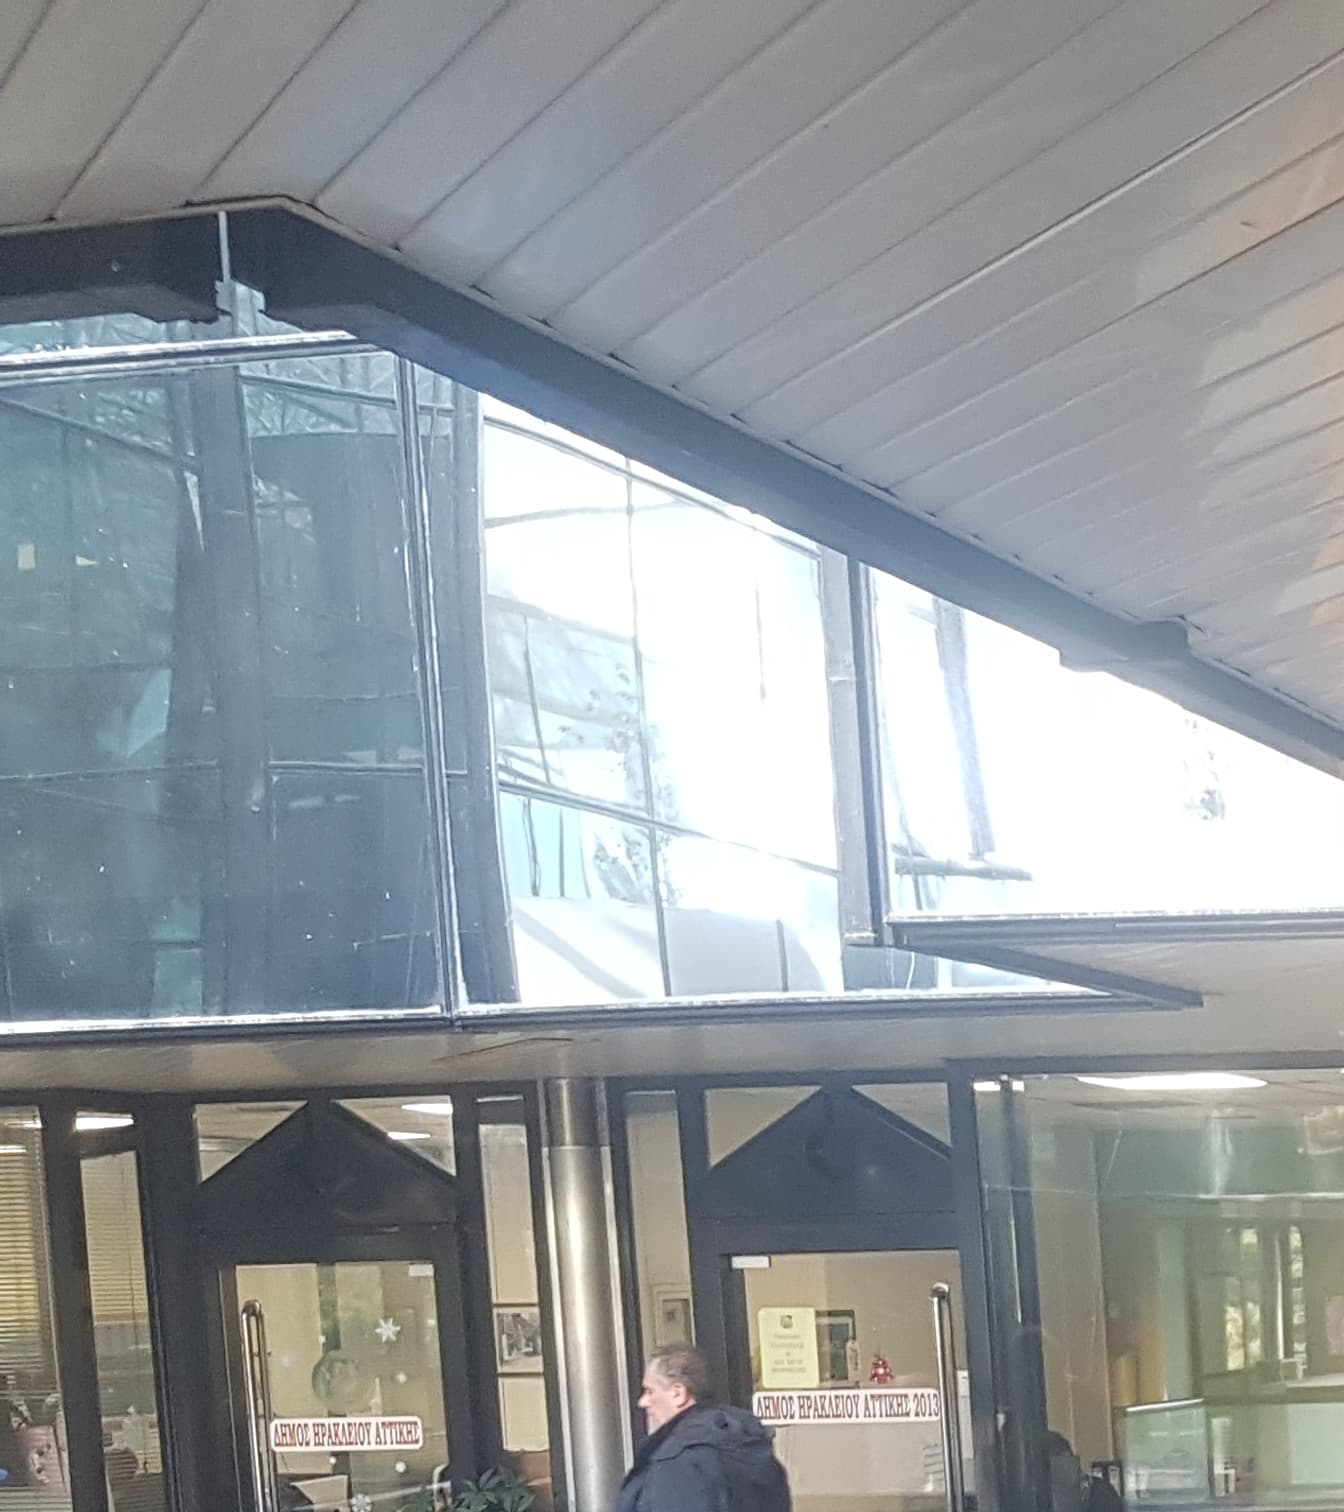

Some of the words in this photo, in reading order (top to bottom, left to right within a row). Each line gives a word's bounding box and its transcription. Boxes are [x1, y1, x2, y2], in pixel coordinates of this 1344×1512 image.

[757, 1393, 796, 1420] ΔΗΜΟΣ
[798, 1392, 862, 1419] ΗΡΑΚΛΕΙΟΥ
[863, 1391, 911, 1418] ΑΤΤΙΚΗΣ
[913, 1391, 940, 1417] 2013
[274, 1422, 310, 1447] ΔΗΜΟΣ
[312, 1421, 372, 1447] ΗΡΑΚΛΕΙΟΥ
[374, 1420, 420, 1446] ΑΤΤΙΚΗΣ
